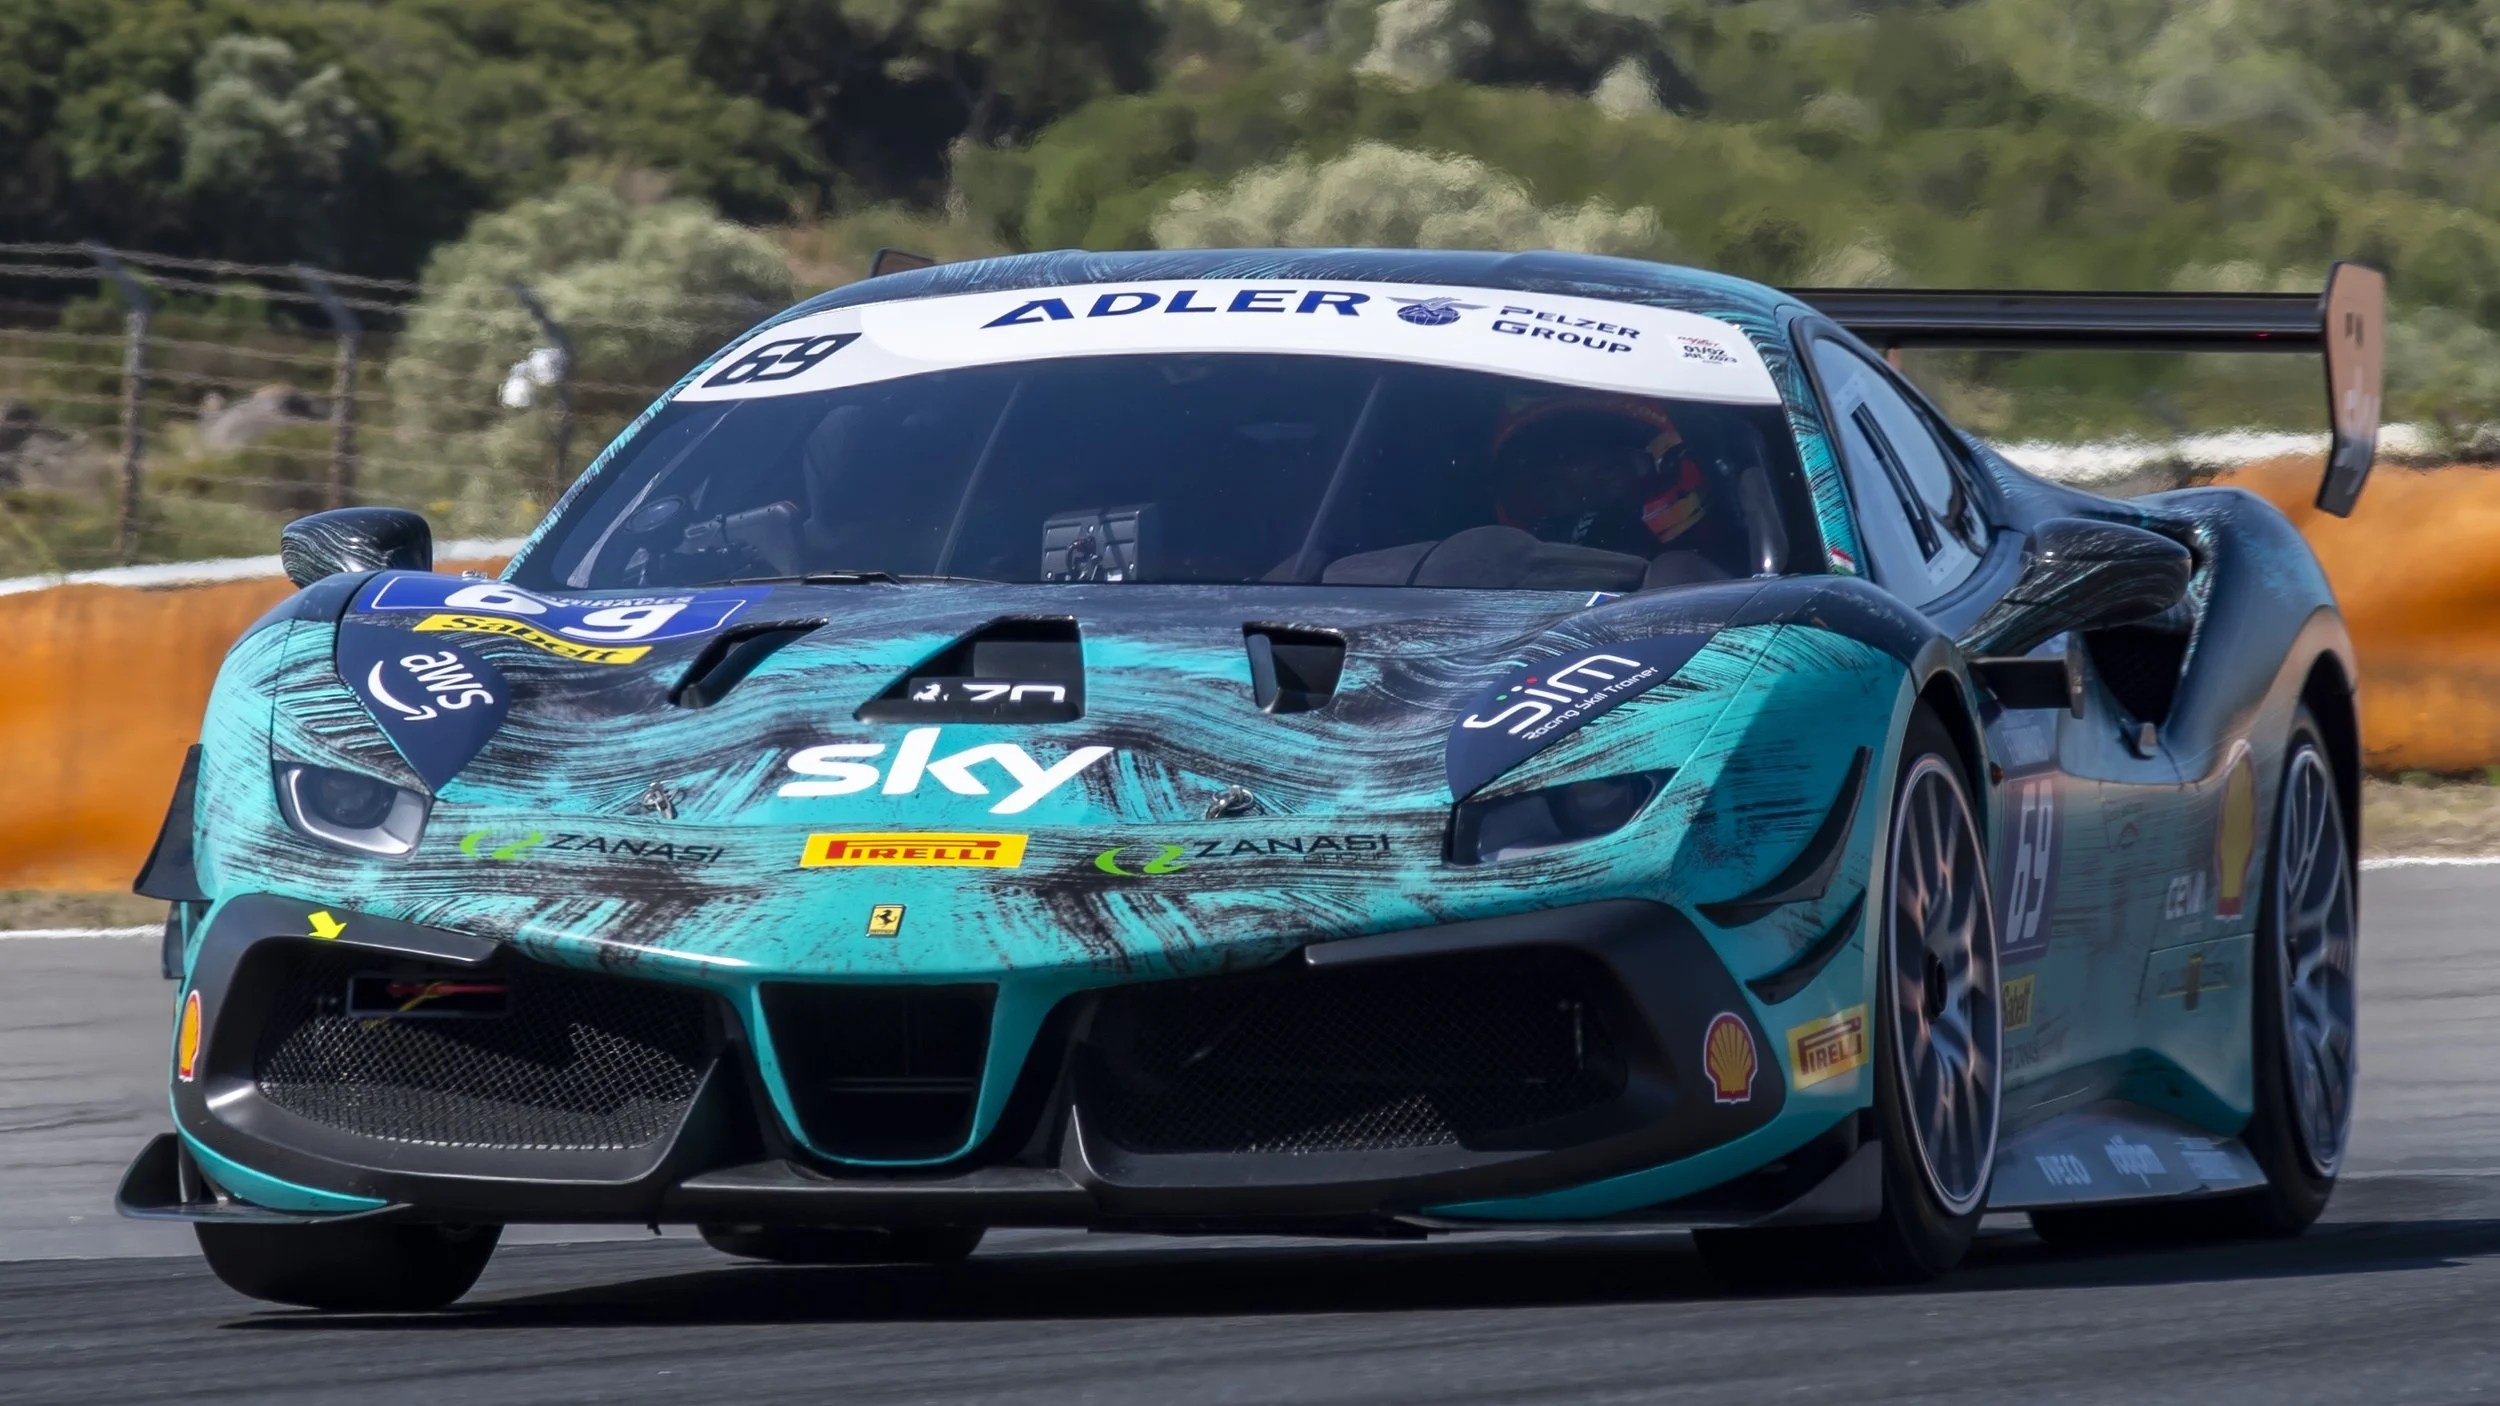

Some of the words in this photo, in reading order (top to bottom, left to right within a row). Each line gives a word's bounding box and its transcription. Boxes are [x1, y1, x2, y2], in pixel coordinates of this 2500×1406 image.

[979, 289, 1371, 329] ADLER
[1499, 305, 1641, 340] PELZER
[701, 332, 863, 388] 69
[1491, 319, 1632, 353] GROUP
[444, 583, 688, 640] 69
[441, 616, 622, 662] Sabelt
[400, 650, 494, 710] aws
[1522, 708, 1580, 740] Racing
[1574, 692, 1609, 712] Skill
[1602, 665, 1660, 695] Trainer
[777, 727, 1115, 815] sky
[546, 832, 725, 864] ZANASI
[824, 839, 1002, 860] PIRELLI
[1192, 833, 1391, 858] ZANASI
[2005, 778, 2054, 945] 69
[1796, 1015, 1862, 1076] PIRELLI
